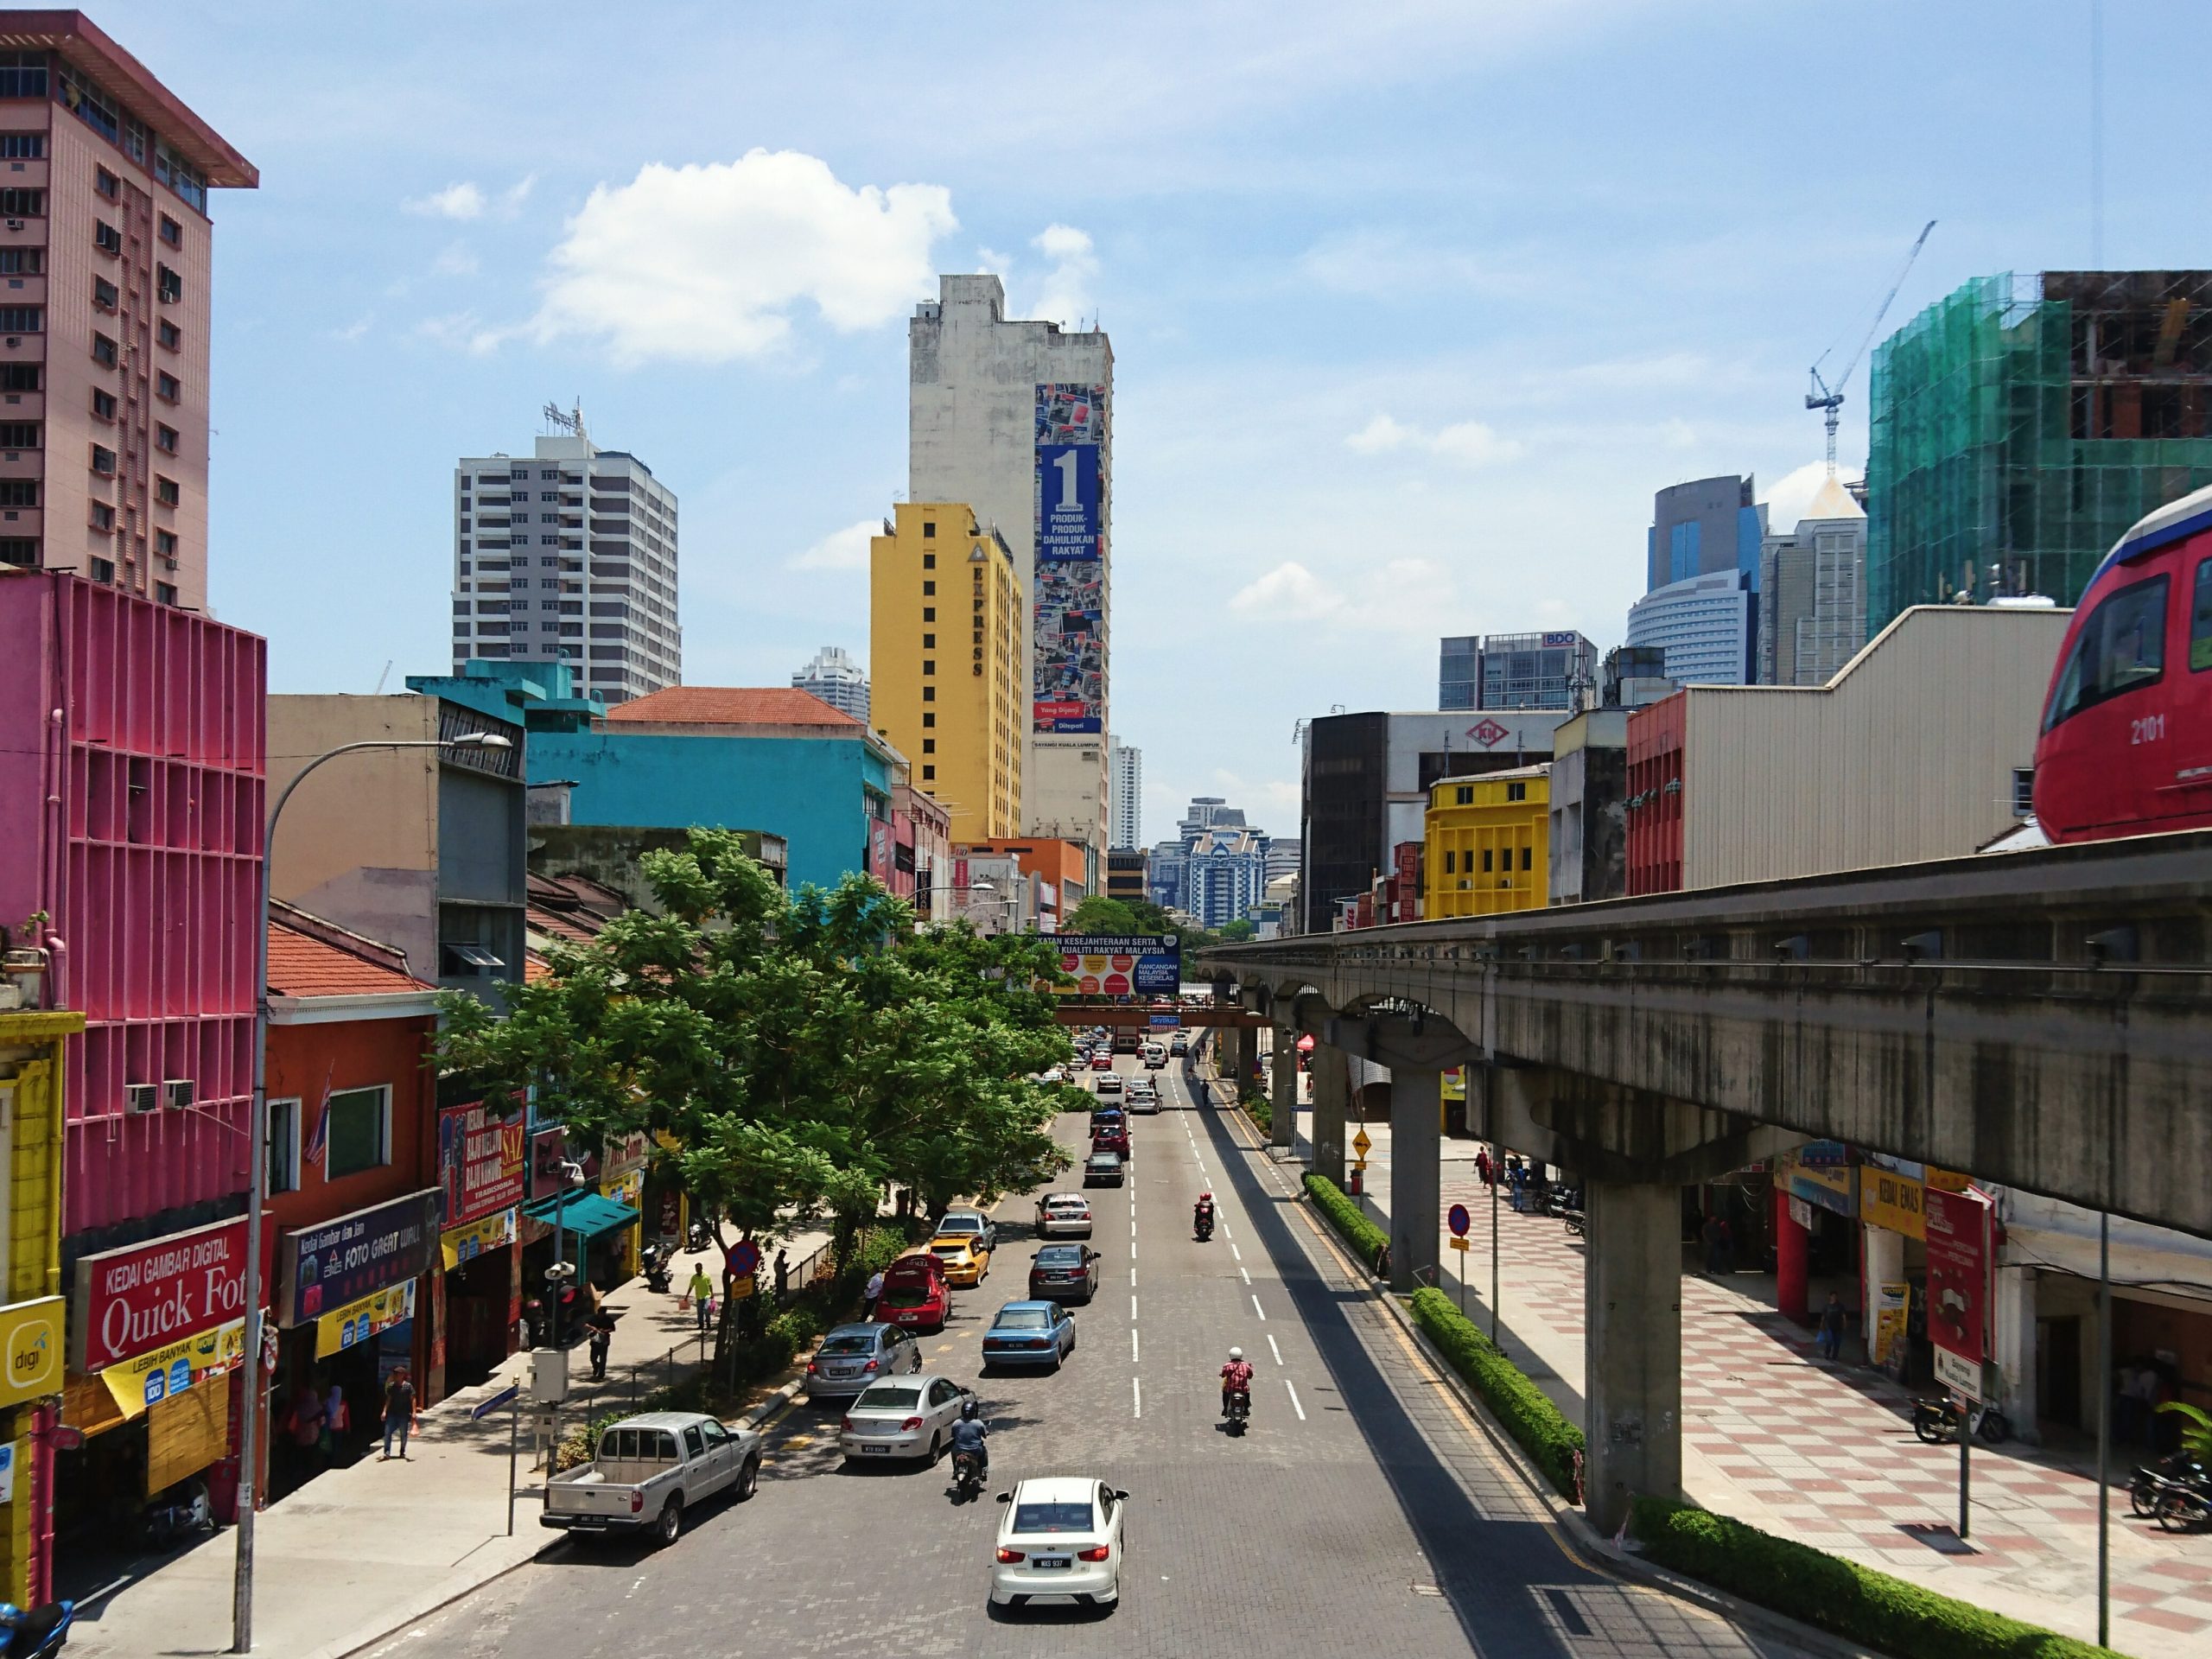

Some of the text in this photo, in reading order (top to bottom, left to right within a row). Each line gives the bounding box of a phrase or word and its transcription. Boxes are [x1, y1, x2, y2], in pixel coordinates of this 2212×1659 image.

[1053, 449, 1084, 512] 1
[1050, 514, 1088, 523] PRODUK-
[1052, 524, 1086, 534] PRODUK
[1043, 535, 1095, 544] DAHULUKAN
[1052, 546, 1086, 555] RAKYAT
[973, 568, 984, 677] EXPRESS
[1547, 632, 1575, 644] BDO
[1058, 707, 1080, 715] Dijanji
[2131, 714, 2164, 745] 2101
[1061, 946, 1092, 955] KUALITI
[1065, 938, 1129, 946] KESEJAHTERAAN
[503, 1125, 524, 1166] SAZ
[474, 1178, 515, 1199] TRADISIONAL
[345, 1243, 369, 1271] FOTO
[372, 1231, 399, 1260] GREAT
[400, 1224, 420, 1249] WALL
[105, 1236, 230, 1296] KEDAI GAMBAR DIGITAL
[102, 1265, 263, 1358] Quick Fot
[15, 1351, 40, 1371] digi
[132, 1340, 192, 1374] LEBIH BANYAK
[148, 1384, 162, 1400] IDD
